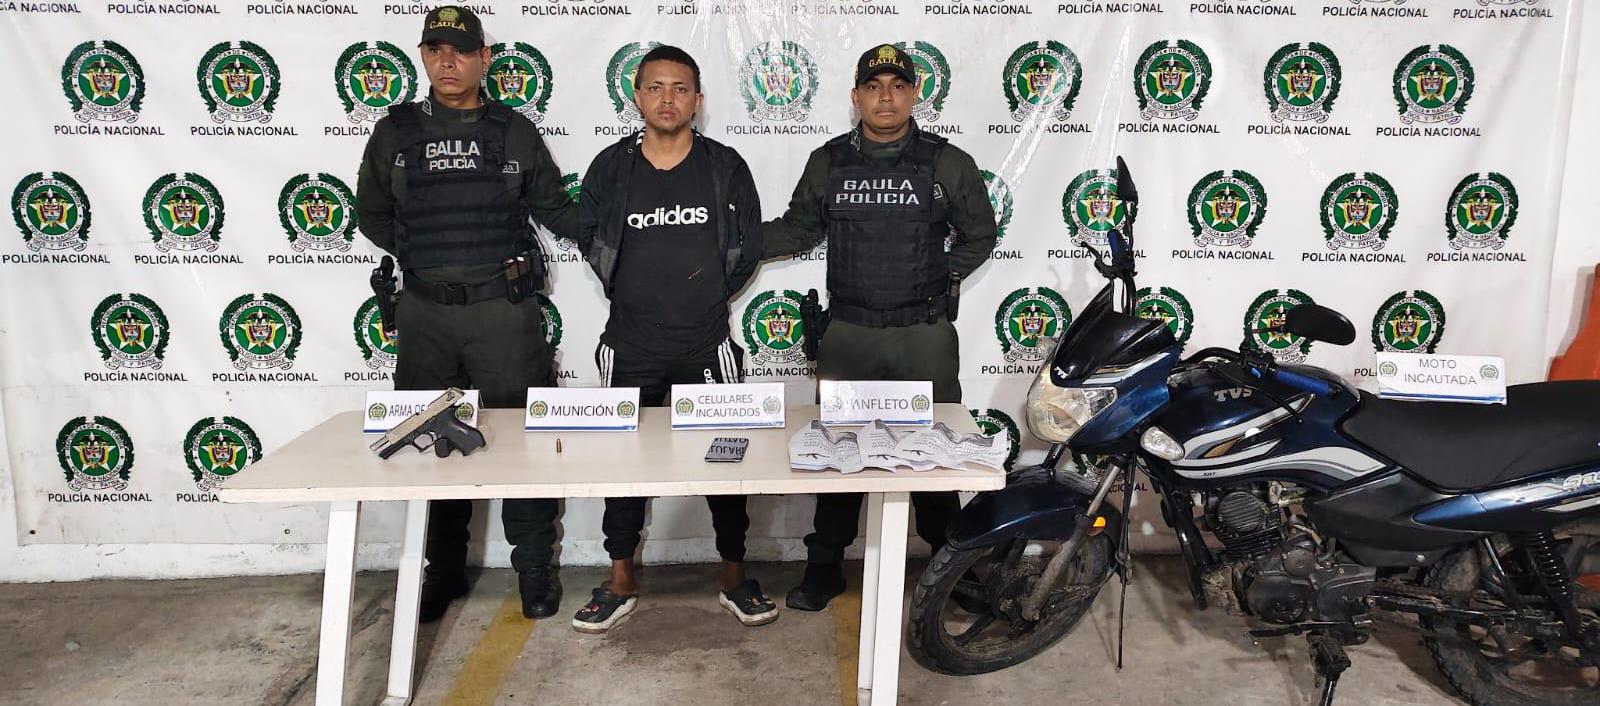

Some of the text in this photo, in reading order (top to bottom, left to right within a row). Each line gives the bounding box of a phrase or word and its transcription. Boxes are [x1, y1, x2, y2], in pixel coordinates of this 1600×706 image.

[21, 3, 80, 13] NACIONAL
[108, 2, 220, 13] POLICÍA NACIONAL
[248, 3, 358, 14] POLICÍA NACIONAL
[384, 3, 430, 14] POLICÍA
[522, 4, 631, 15] POLICÍA NACIONAL
[657, 3, 698, 14] POLICÍ
[840, 6, 899, 14] NACIONAL
[925, 3, 1032, 14] POLICÍA NACIONAL
[1058, 2, 1163, 13] POLICÍA NACIONAL
[1190, 3, 1296, 15] POLICÍA NACIONAL
[1323, 5, 1428, 17] POLICÍA NACIONAL
[1453, 8, 1552, 18] POLICÍA NACIONAL
[429, 21, 467, 31] GAULA
[869, 58, 905, 69] GAULA
[54, 124, 165, 135] POLICÍA NACIONAL
[191, 124, 298, 135] POLICÍA NACIONAL
[324, 125, 370, 136] POLICÍA
[538, 126, 569, 135] ONAL
[727, 123, 832, 134] POLICÍA NACIONAL
[921, 125, 963, 134] CIONAL
[1119, 122, 1220, 133] POLICÍA NACIONAL
[1248, 124, 1351, 135] POLICÍA NACIONAL
[1377, 126, 1480, 136] POLICÍA NACIONAL
[426, 140, 480, 158] GAULA
[843, 179, 913, 190] GAULA
[835, 193, 920, 204] POLICIA
[627, 205, 709, 229] adidas
[3, 252, 110, 263] POLICÍA NACIONAL
[135, 253, 243, 264] POLICÍA NACIONAL
[268, 253, 376, 263] POLICÍA NACIONAL
[544, 251, 578, 262] OLICÍA
[793, 252, 824, 261] POLIC
[991, 250, 1023, 260] IONAL
[1048, 249, 1092, 258] POLICÍA
[1172, 248, 1274, 260] POLICÍA NACIONAL
[1302, 251, 1406, 262] POLICÍA NACIONAL
[1427, 251, 1526, 261] POLICÍA NACIONAL
[982, 363, 1024, 374] POLICÍA
[1419, 358, 1457, 369] MOTO
[84, 370, 187, 381] POLICÍA NACIONAL
[213, 370, 318, 381] POLICÍA NACIONAL
[345, 370, 388, 381] POLICÍA
[740, 365, 816, 376] OLICÍA NACION
[1053, 367, 1068, 379] TVS
[1404, 373, 1477, 385] INCAUTADA
[698, 394, 753, 405] CELULARES
[1213, 387, 1252, 402] TVS
[852, 398, 908, 410] ANFLETO
[389, 404, 412, 416] ARMA
[551, 404, 614, 416] MUNICIÓN
[696, 408, 760, 418] INCAUTADOS
[48, 492, 152, 502] POLICÍA NACIONAL
[177, 492, 219, 502] POLICÍA
